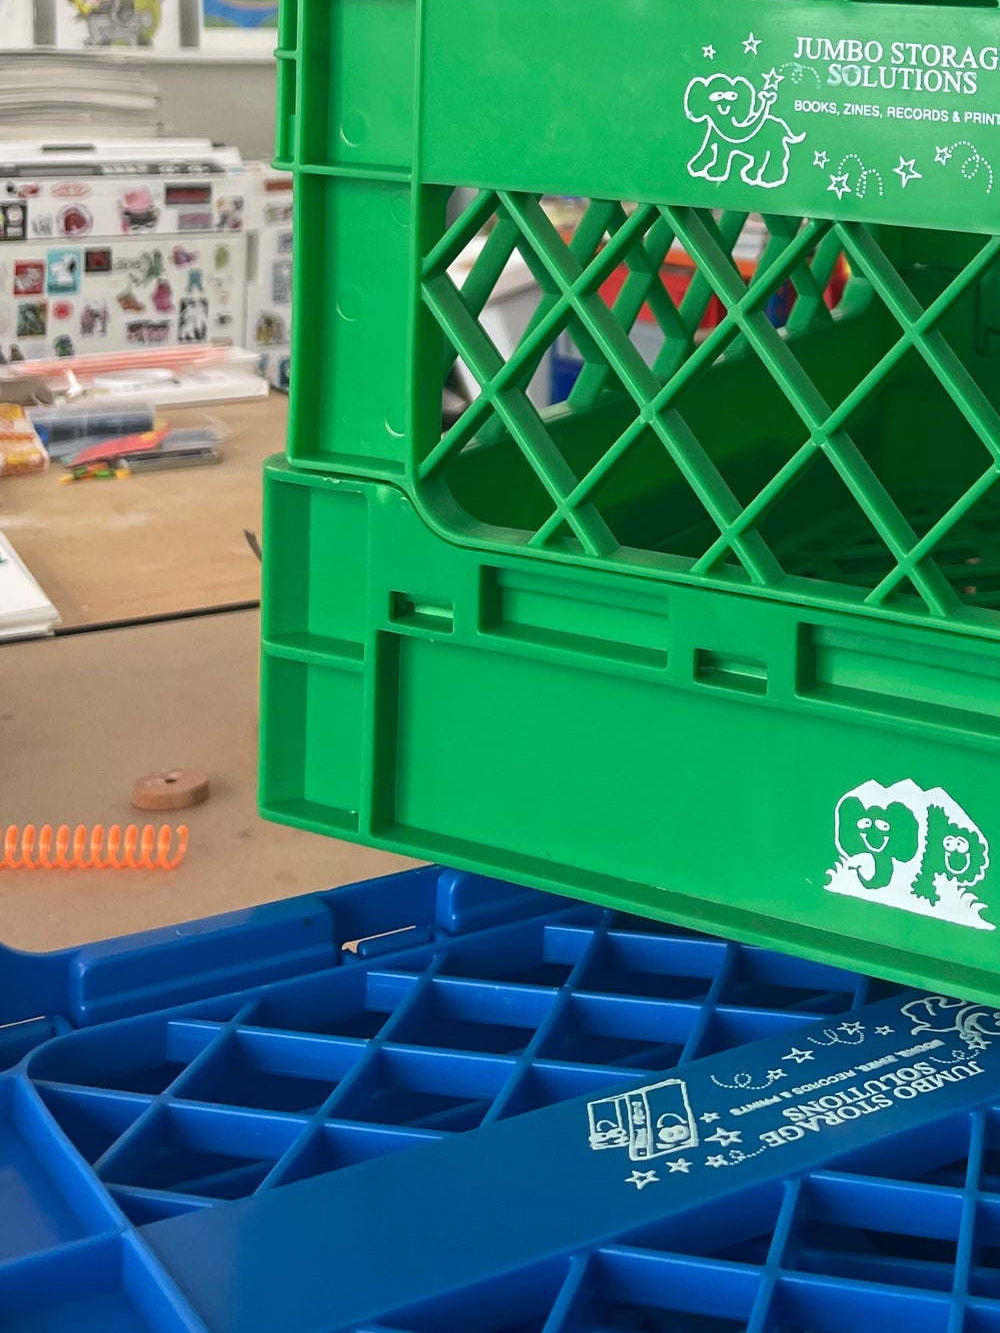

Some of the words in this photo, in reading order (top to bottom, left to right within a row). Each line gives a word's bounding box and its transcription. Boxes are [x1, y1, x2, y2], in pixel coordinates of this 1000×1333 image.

[794, 37, 883, 64] JUMBO
[827, 63, 978, 94] SOLUTIONS
[794, 100, 840, 115] BOOKS,
[843, 102, 883, 118] ZINES,
[887, 106, 949, 122] RECORDS
[952, 111, 961, 123] &
[782, 1061, 938, 1122] SOLUTIONS
[792, 1070, 857, 1095] RECORDS
[893, 1061, 985, 1100] JUMBO
[759, 1094, 894, 1147] STORAGE
